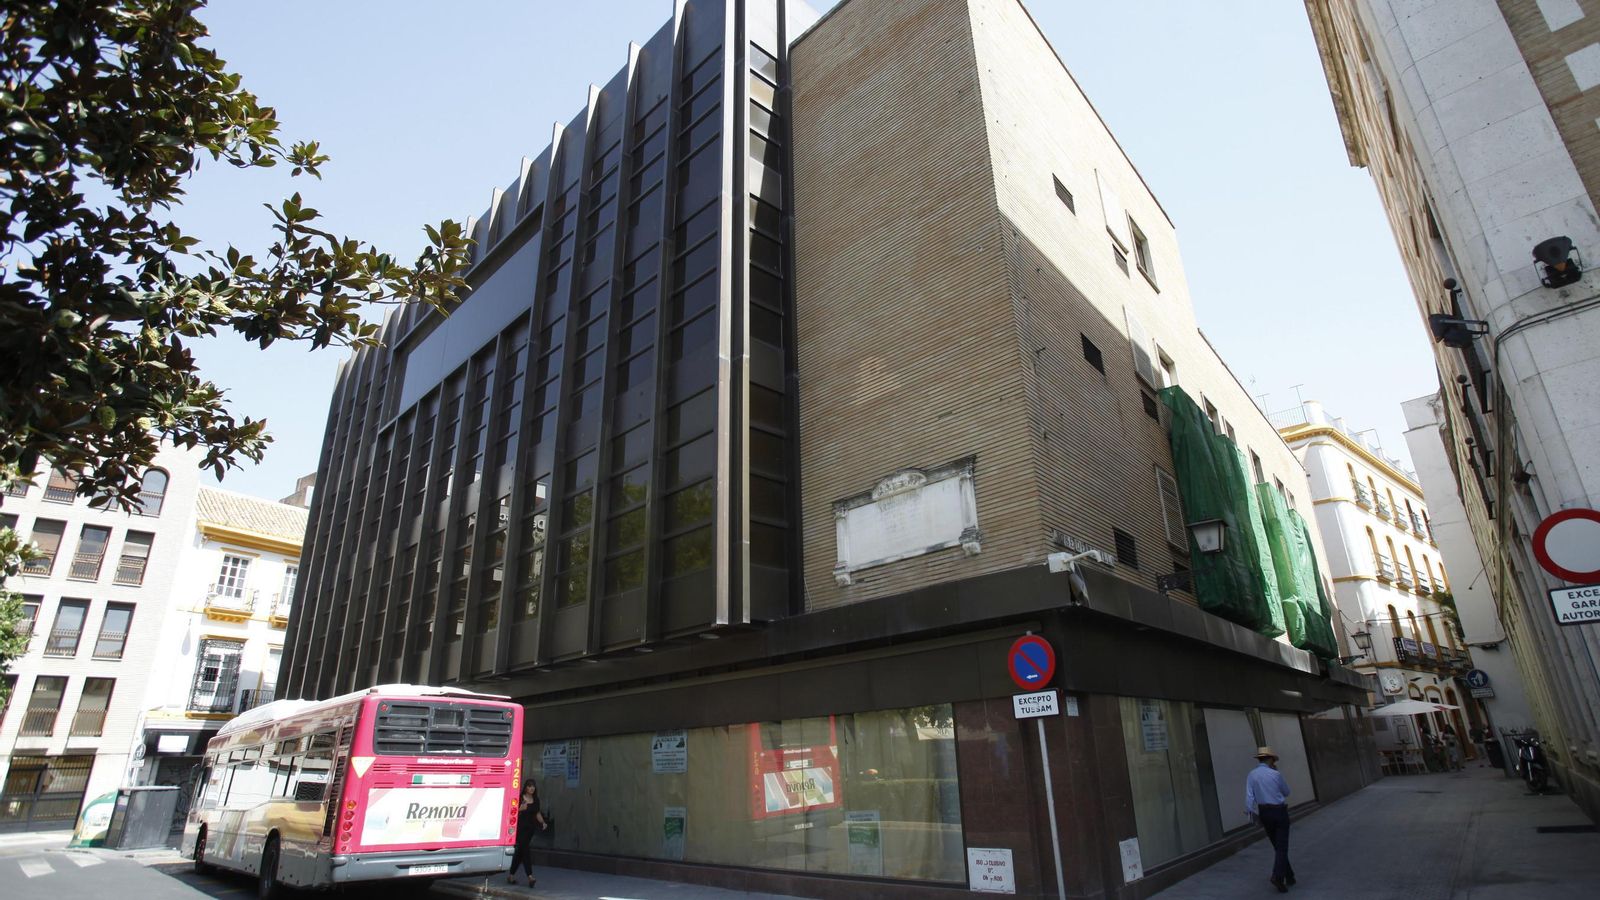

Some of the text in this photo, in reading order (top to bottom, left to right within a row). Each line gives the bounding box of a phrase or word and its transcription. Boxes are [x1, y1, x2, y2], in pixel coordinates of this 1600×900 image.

[1568, 588, 1600, 599] EXCE
[1571, 600, 1600, 609] GAR
[1562, 609, 1600, 621] AUTOR
[1018, 694, 1052, 705] EXCEPTO
[512, 757, 520, 789] 126
[406, 802, 468, 820] Renova
